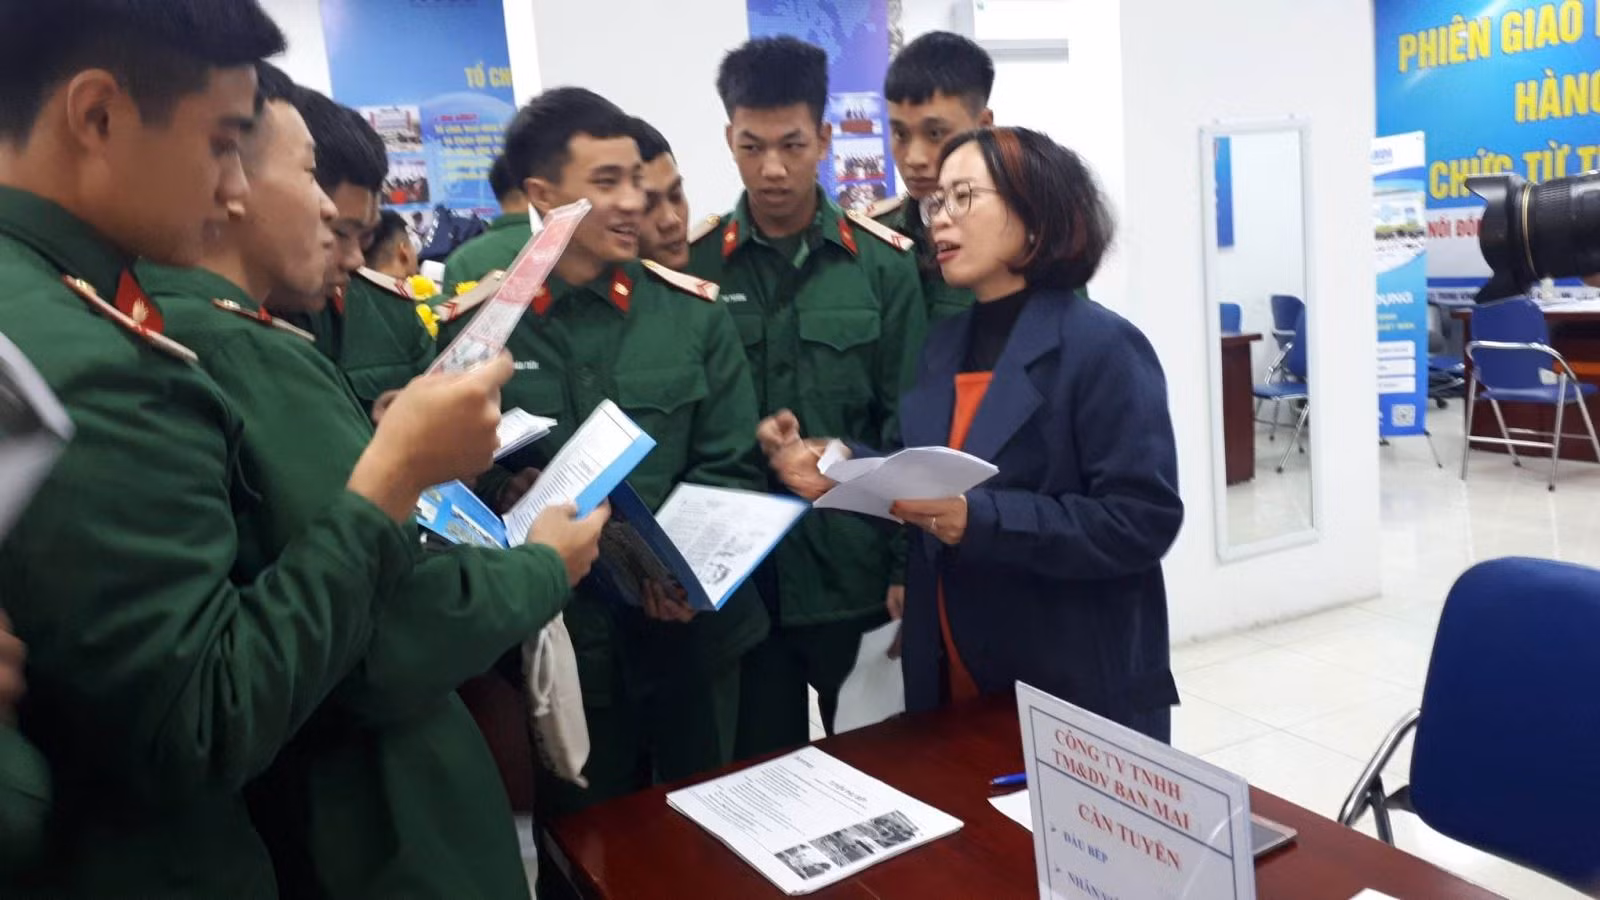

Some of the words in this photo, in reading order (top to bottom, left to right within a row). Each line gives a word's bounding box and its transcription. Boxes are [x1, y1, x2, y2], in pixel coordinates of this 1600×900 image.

[1398, 14, 1492, 73] PHIÊN
[1501, 0, 1584, 54] GIAO
[1053, 748, 1109, 788] TM&DV
[1114, 780, 1150, 809] BAN
[1153, 797, 1190, 830] MAI
[1055, 729, 1100, 762] CÔNG
[1103, 750, 1125, 774] TY
[1130, 762, 1181, 801] TNHH
